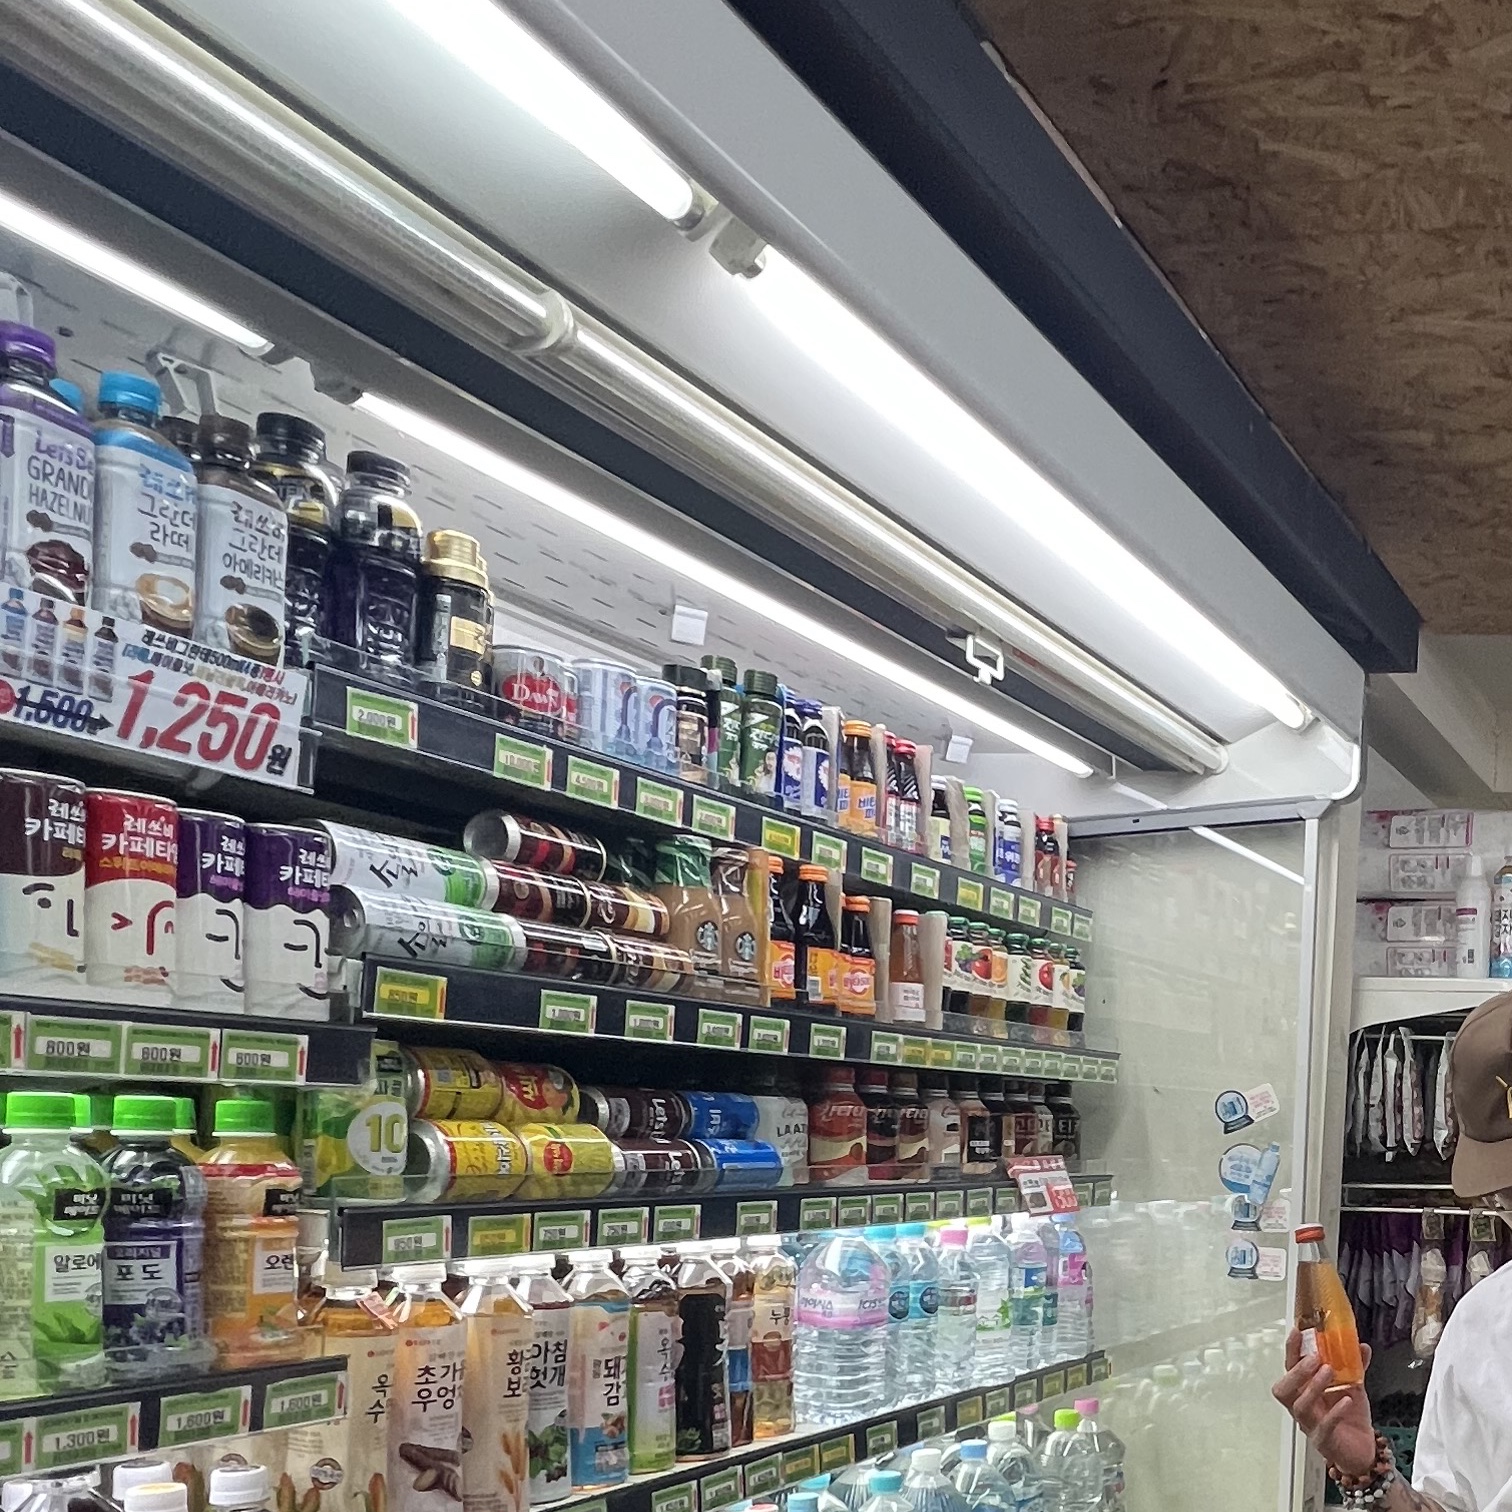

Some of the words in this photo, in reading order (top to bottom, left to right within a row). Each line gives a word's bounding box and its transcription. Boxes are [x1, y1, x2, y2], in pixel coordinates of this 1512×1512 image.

[46, 1040, 91, 1057] 800원
[141, 1047, 182, 1062] 800원
[236, 1052, 272, 1067] 800원
[415, 1361, 464, 1386] 초가
[411, 1387, 463, 1413] 우엉
[55, 1431, 111, 1451] 1,300원
